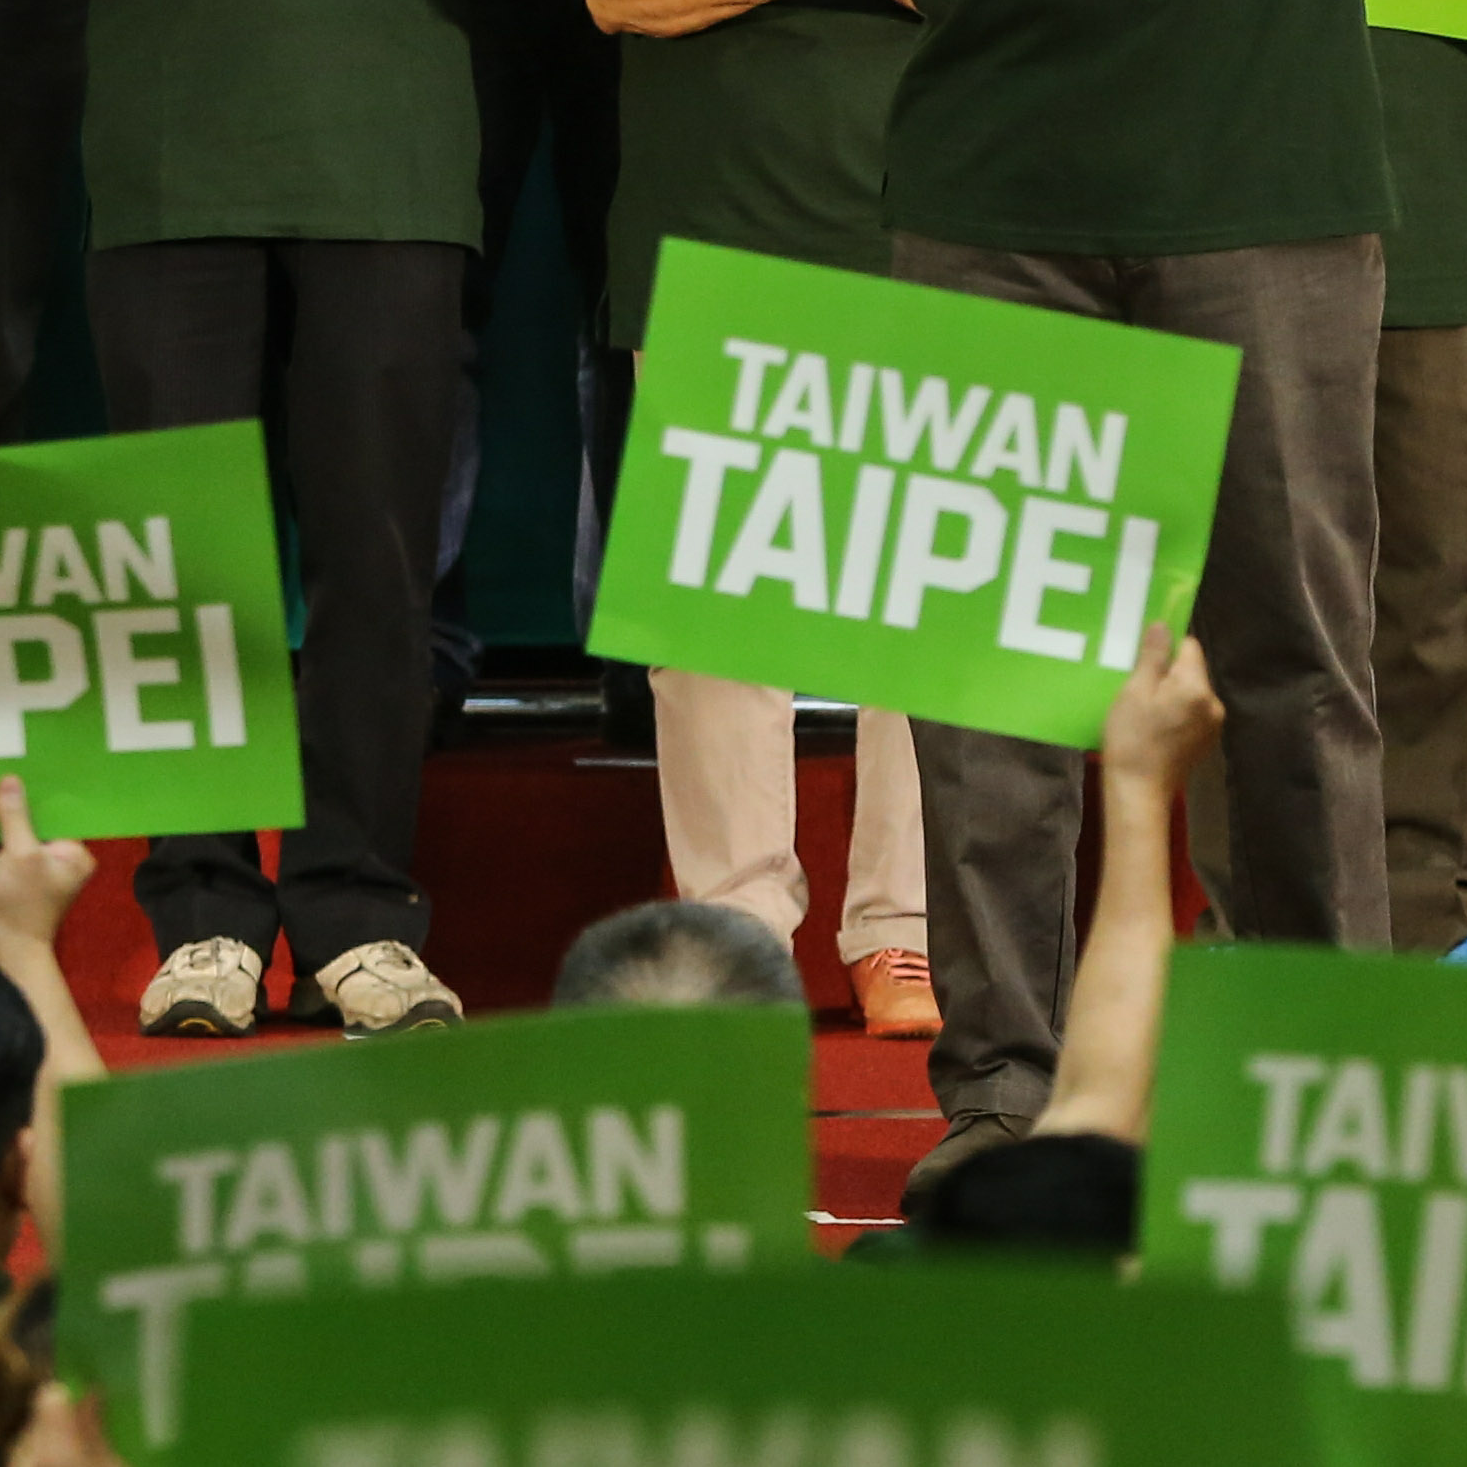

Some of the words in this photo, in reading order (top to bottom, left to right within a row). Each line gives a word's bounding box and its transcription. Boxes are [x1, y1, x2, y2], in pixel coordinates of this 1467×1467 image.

[723, 338, 1128, 503] TAIWAN
[660, 426, 1160, 673] TAIPEI
[157, 1105, 687, 1254] TAIWAN
